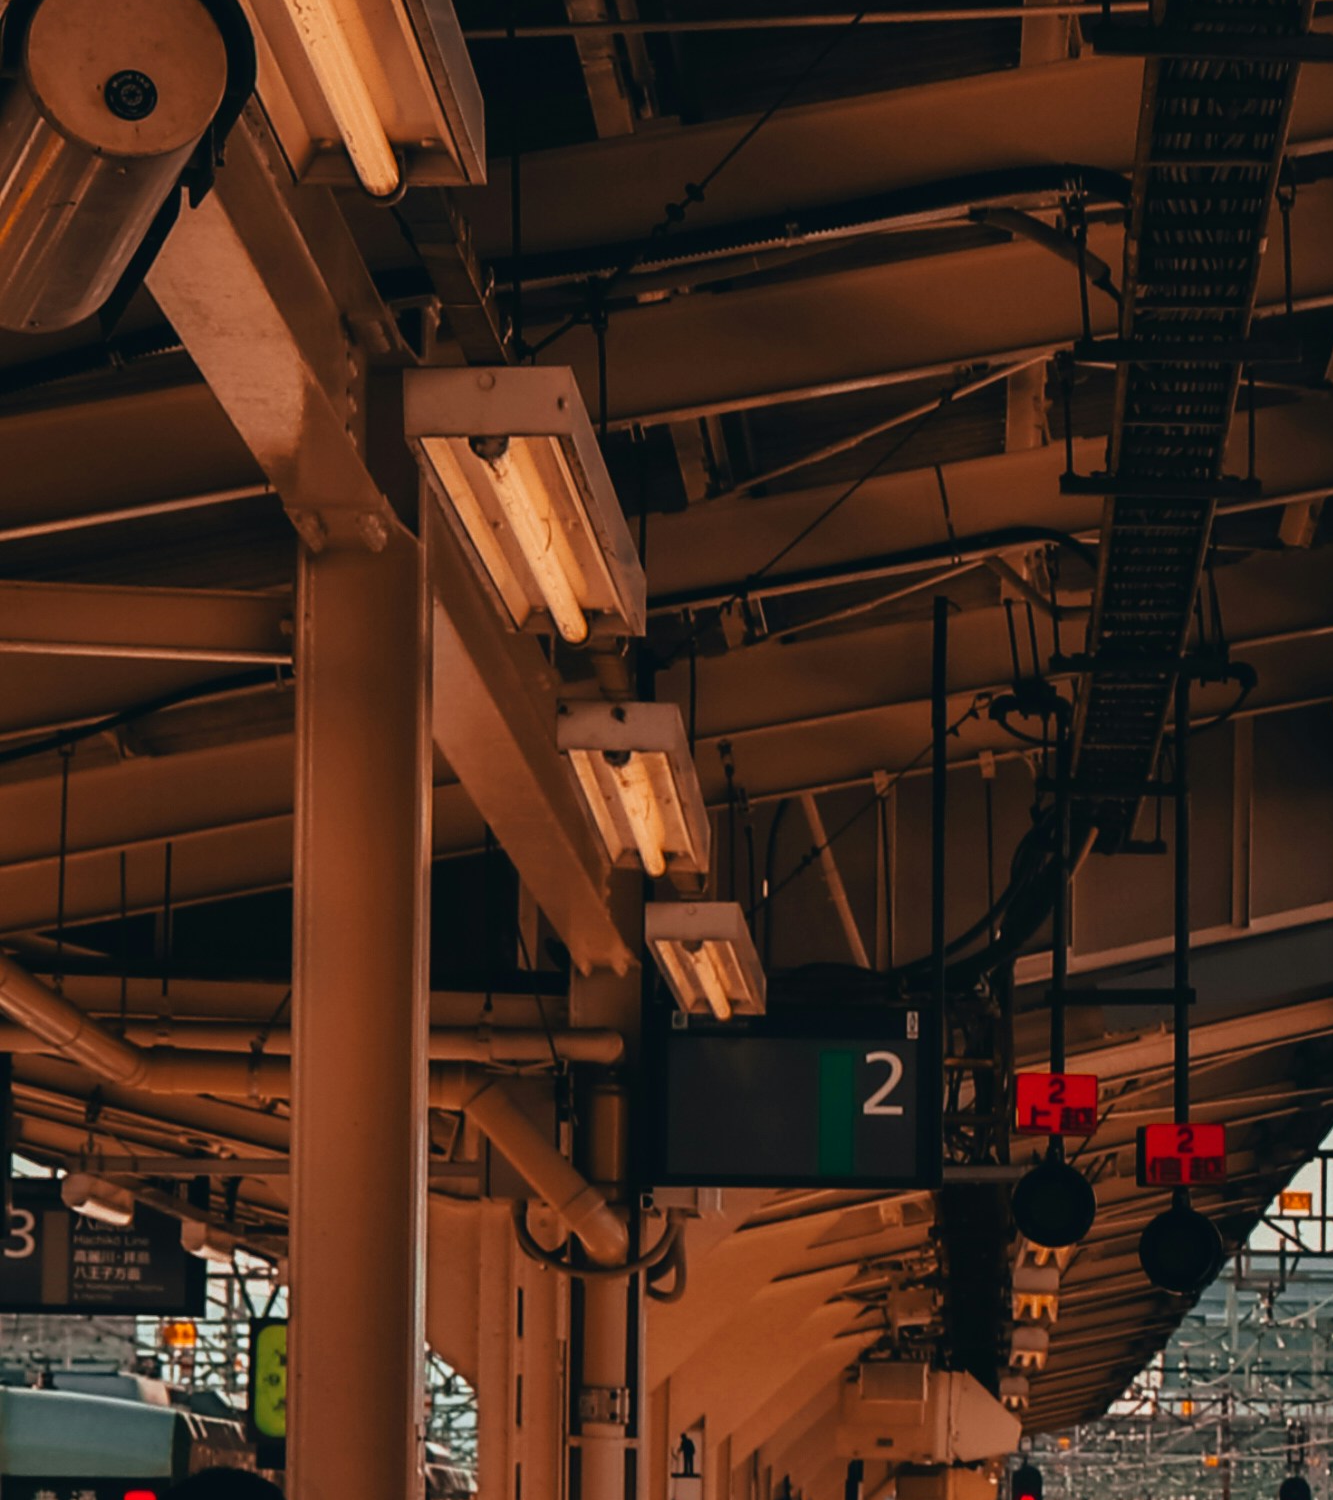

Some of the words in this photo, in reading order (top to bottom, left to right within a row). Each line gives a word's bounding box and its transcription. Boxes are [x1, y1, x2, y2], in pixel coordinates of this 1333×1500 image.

[862, 1049, 905, 1116] 2
[1049, 1078, 1066, 1104] 2
[1176, 1127, 1194, 1154] 2
[3, 1206, 37, 1260] 3
